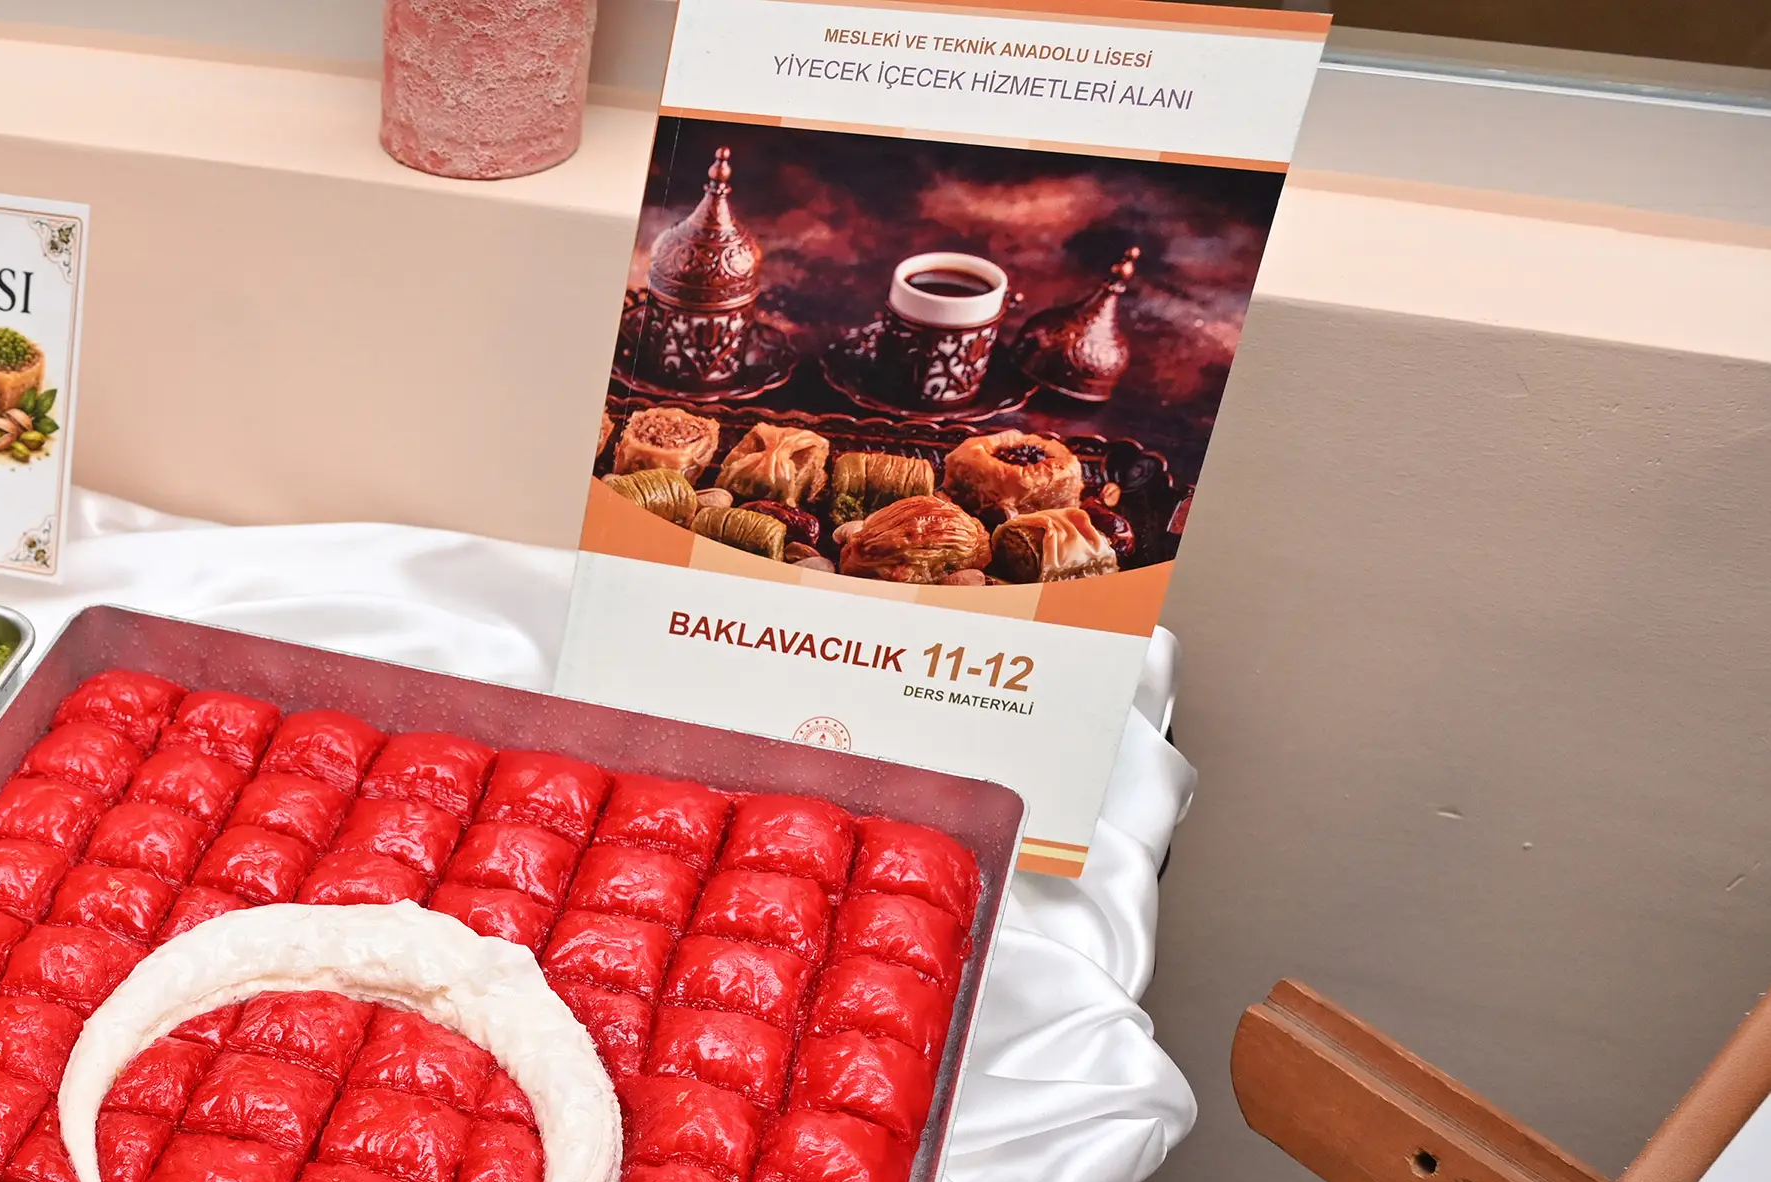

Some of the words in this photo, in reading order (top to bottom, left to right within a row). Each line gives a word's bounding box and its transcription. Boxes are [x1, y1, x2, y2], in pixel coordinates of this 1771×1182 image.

[824, 28, 901, 47] MESLEKİ
[905, 35, 928, 50] VE
[933, 36, 997, 56] TEKNİK
[1000, 42, 1089, 63] ANADOLU
[1093, 46, 1153, 68] LİSESİ
[773, 54, 872, 83] YİYECEK
[877, 61, 966, 90] İÇECEK
[971, 70, 1117, 103] HİZMETLERİ
[1119, 85, 1193, 110] ALANI
[668, 611, 907, 673] BAKLAVACILIK
[922, 642, 1035, 693] 11-12
[903, 684, 945, 702] DERS
[948, 691, 1034, 716] MATERYALİ
